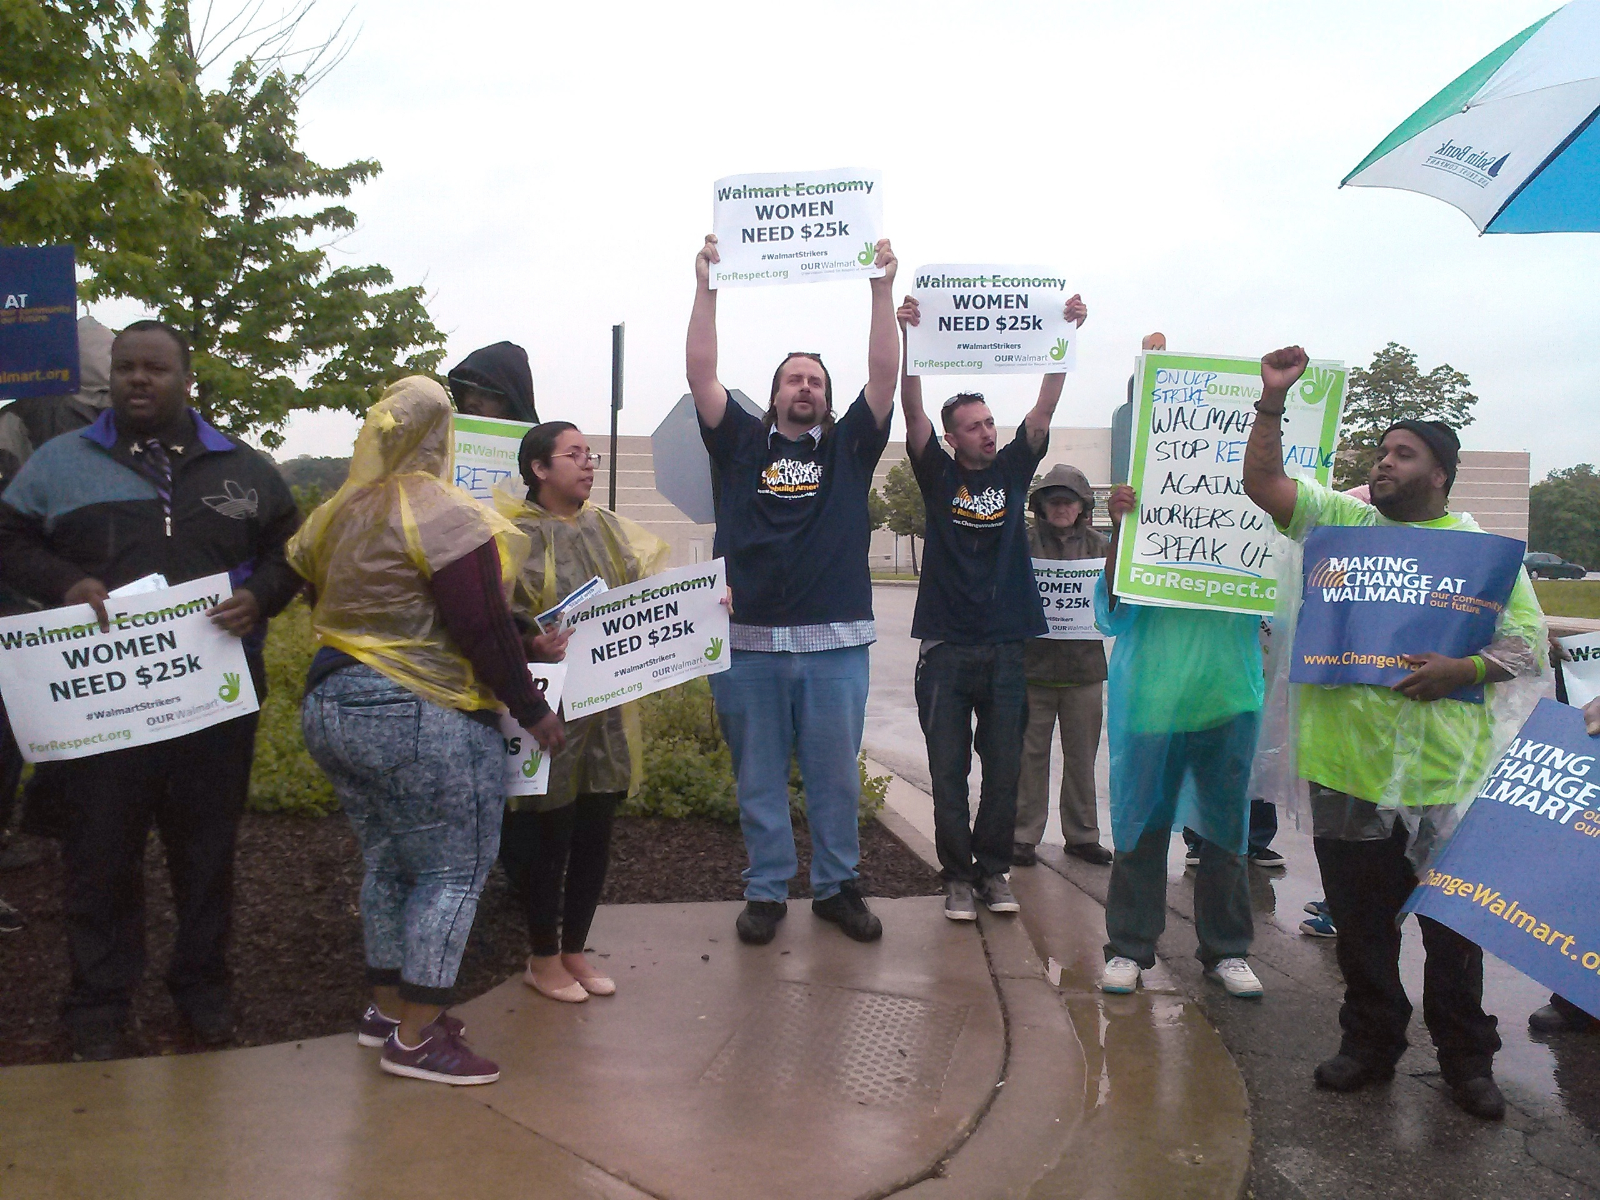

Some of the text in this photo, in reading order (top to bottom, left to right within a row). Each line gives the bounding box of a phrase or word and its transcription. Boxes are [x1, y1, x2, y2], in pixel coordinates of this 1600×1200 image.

[718, 180, 874, 202] Walmart Economy
[755, 200, 834, 221] WOMEN
[742, 221, 850, 243] NEED $25k
[761, 250, 828, 260] #WalmartStrikers
[716, 269, 789, 281] ForRespect.org
[916, 274, 1066, 291] Walmart Economy
[4, 294, 28, 309] AT
[952, 294, 1028, 310] WOMEN
[938, 314, 1043, 334] NEED $25k
[914, 359, 982, 370] ForRespect.org
[0, 368, 70, 384] lmart.org
[1156, 370, 1180, 384] ON
[1151, 386, 1209, 408] STRIKE
[1155, 438, 1210, 462] STOP
[766, 474, 820, 486] WALMAR
[1160, 472, 1247, 496] AGAINS
[1140, 504, 1235, 530] WORKERS
[1141, 532, 1228, 565] SPEAK
[1328, 556, 1418, 573] MAKING
[1036, 581, 1082, 594] OMEN
[1130, 566, 1278, 599] ForRespect.o
[1343, 571, 1467, 594] CHANGE AT
[566, 574, 717, 628] Walmart Economy
[1055, 596, 1090, 611] $25k
[1322, 587, 1430, 606] WALMART
[1430, 592, 1450, 600] our
[1430, 600, 1448, 608] our
[0, 594, 220, 650] Walmar Economy
[602, 600, 679, 637] WOMEN
[62, 630, 176, 670] WOMEN
[591, 620, 695, 664] NEED $25k
[614, 652, 676, 678] #WalmartStrikers
[1304, 651, 1420, 672] www.ChangeWa
[50, 653, 202, 702] NEED $25k
[571, 682, 643, 711] ForRespect.org
[86, 696, 182, 722] #WalmartStrikers
[28, 729, 132, 754] ForRespect.org
[1507, 738, 1596, 776] AKING
[1489, 758, 1600, 806] HANGE
[1478, 779, 1584, 825] LMART
